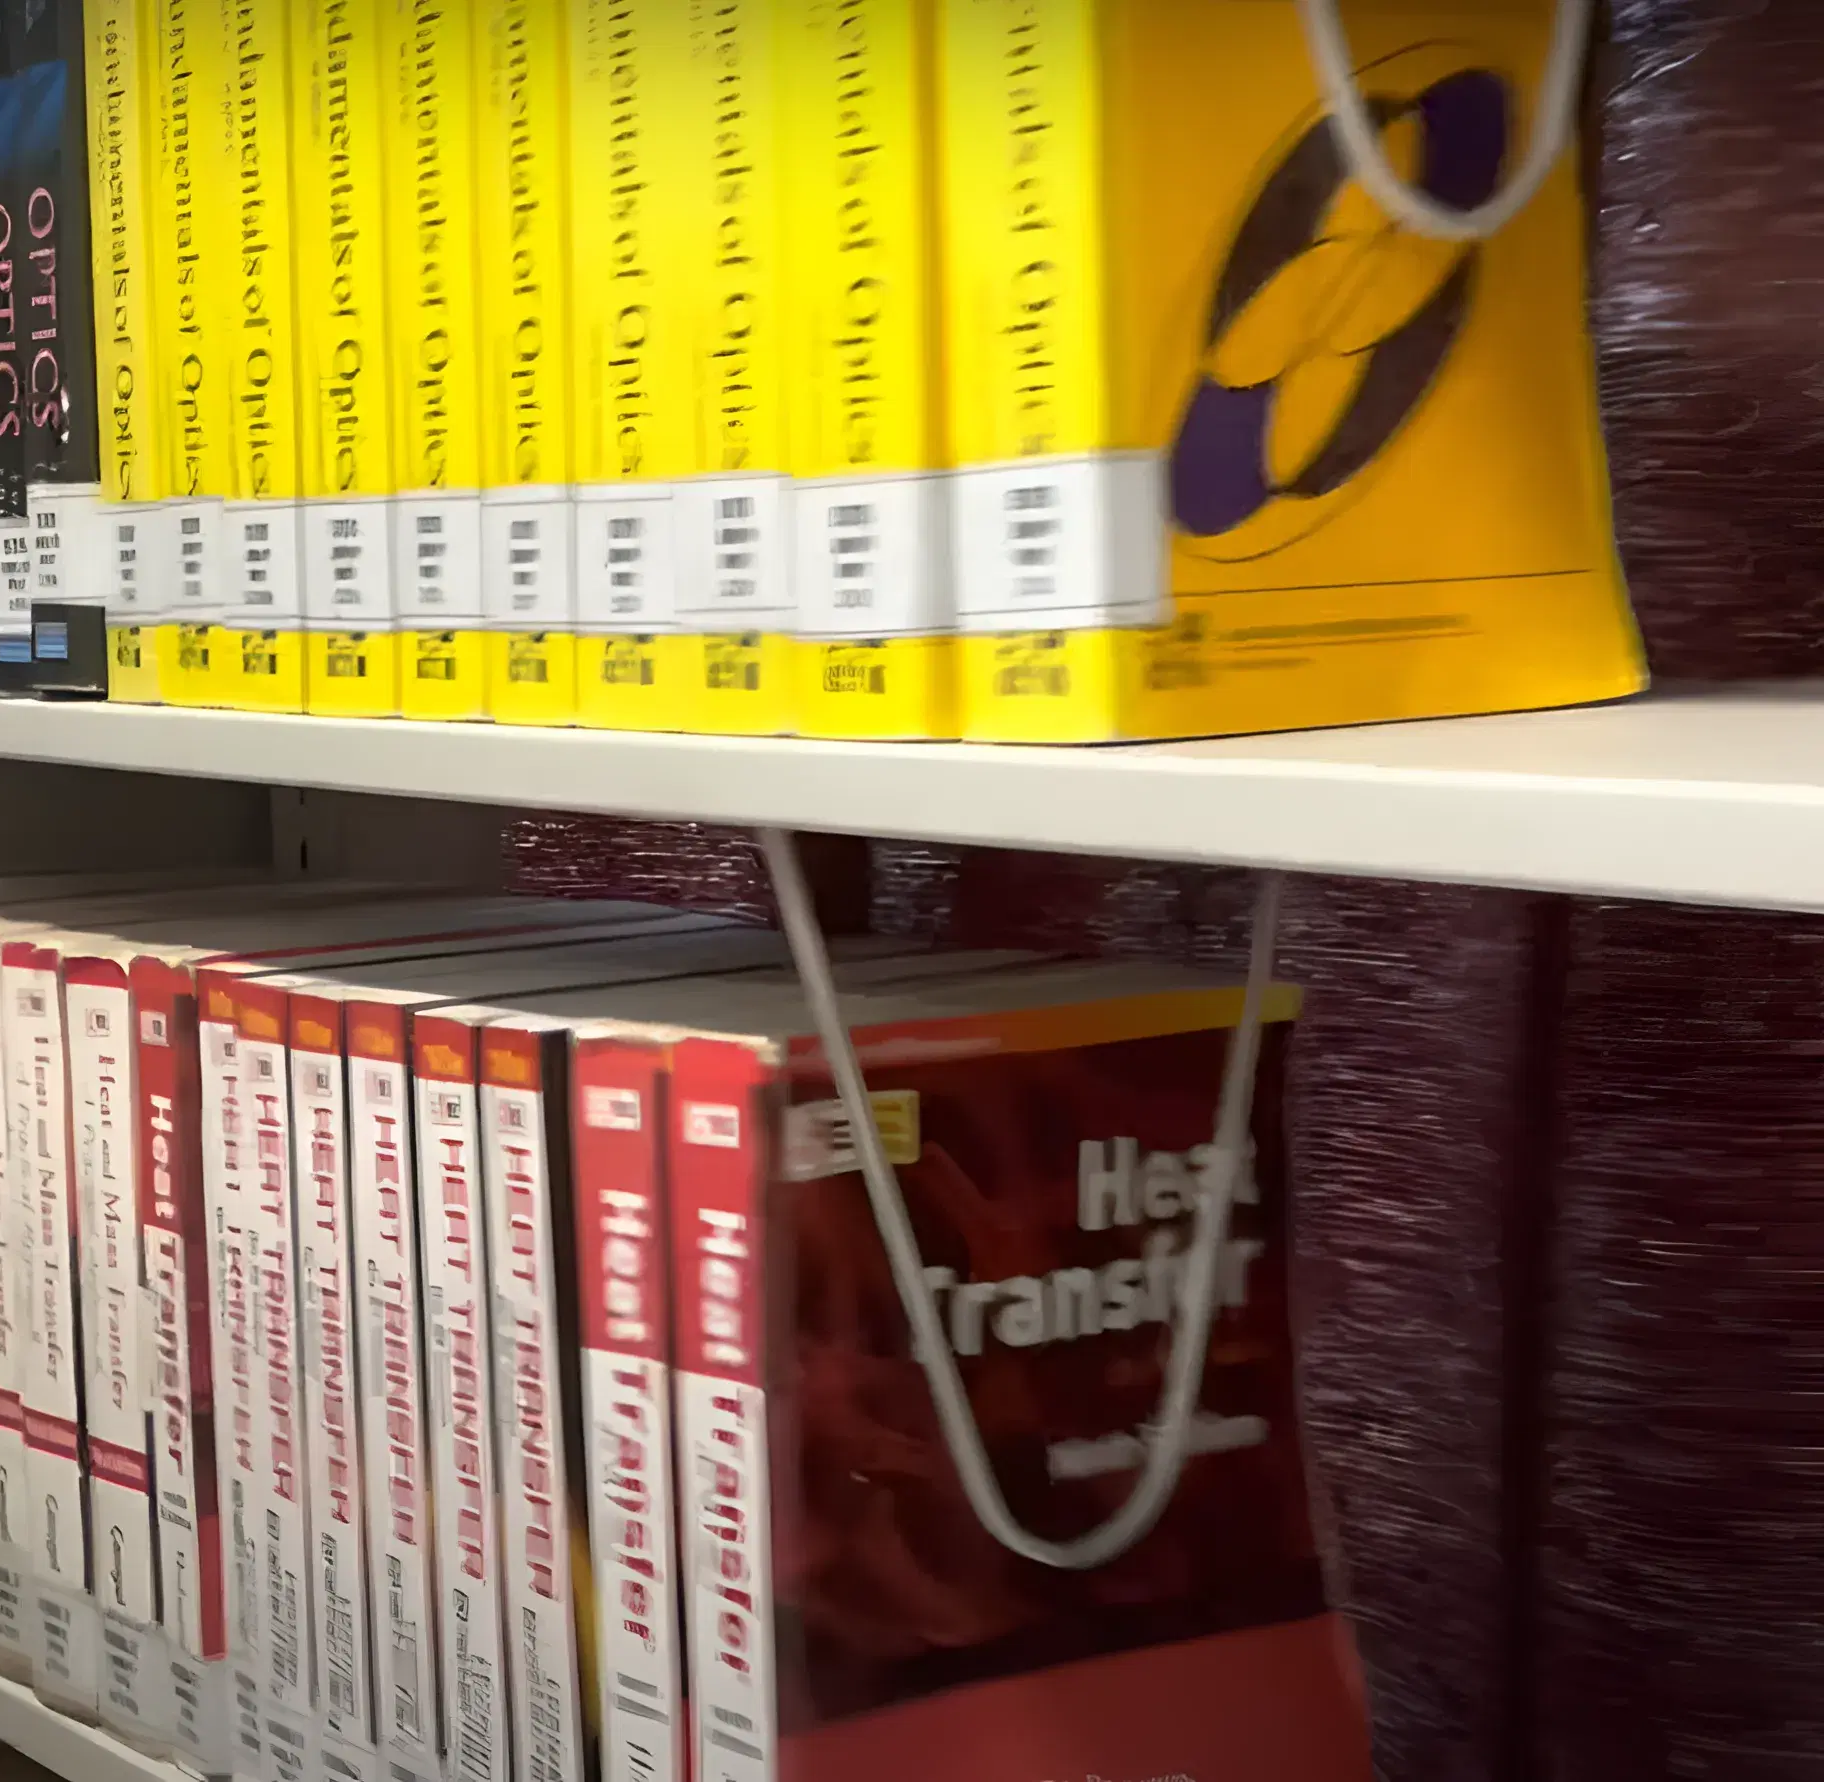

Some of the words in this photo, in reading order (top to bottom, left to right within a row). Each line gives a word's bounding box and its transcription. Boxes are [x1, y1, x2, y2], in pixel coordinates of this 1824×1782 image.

[28, 187, 58, 427] OPTICS
[98, 1054, 116, 1128] Heat
[107, 1286, 129, 1411] Transfer
[150, 1094, 175, 1219] Heat
[599, 1189, 653, 1341] Heat
[697, 1207, 751, 1366] Heat
